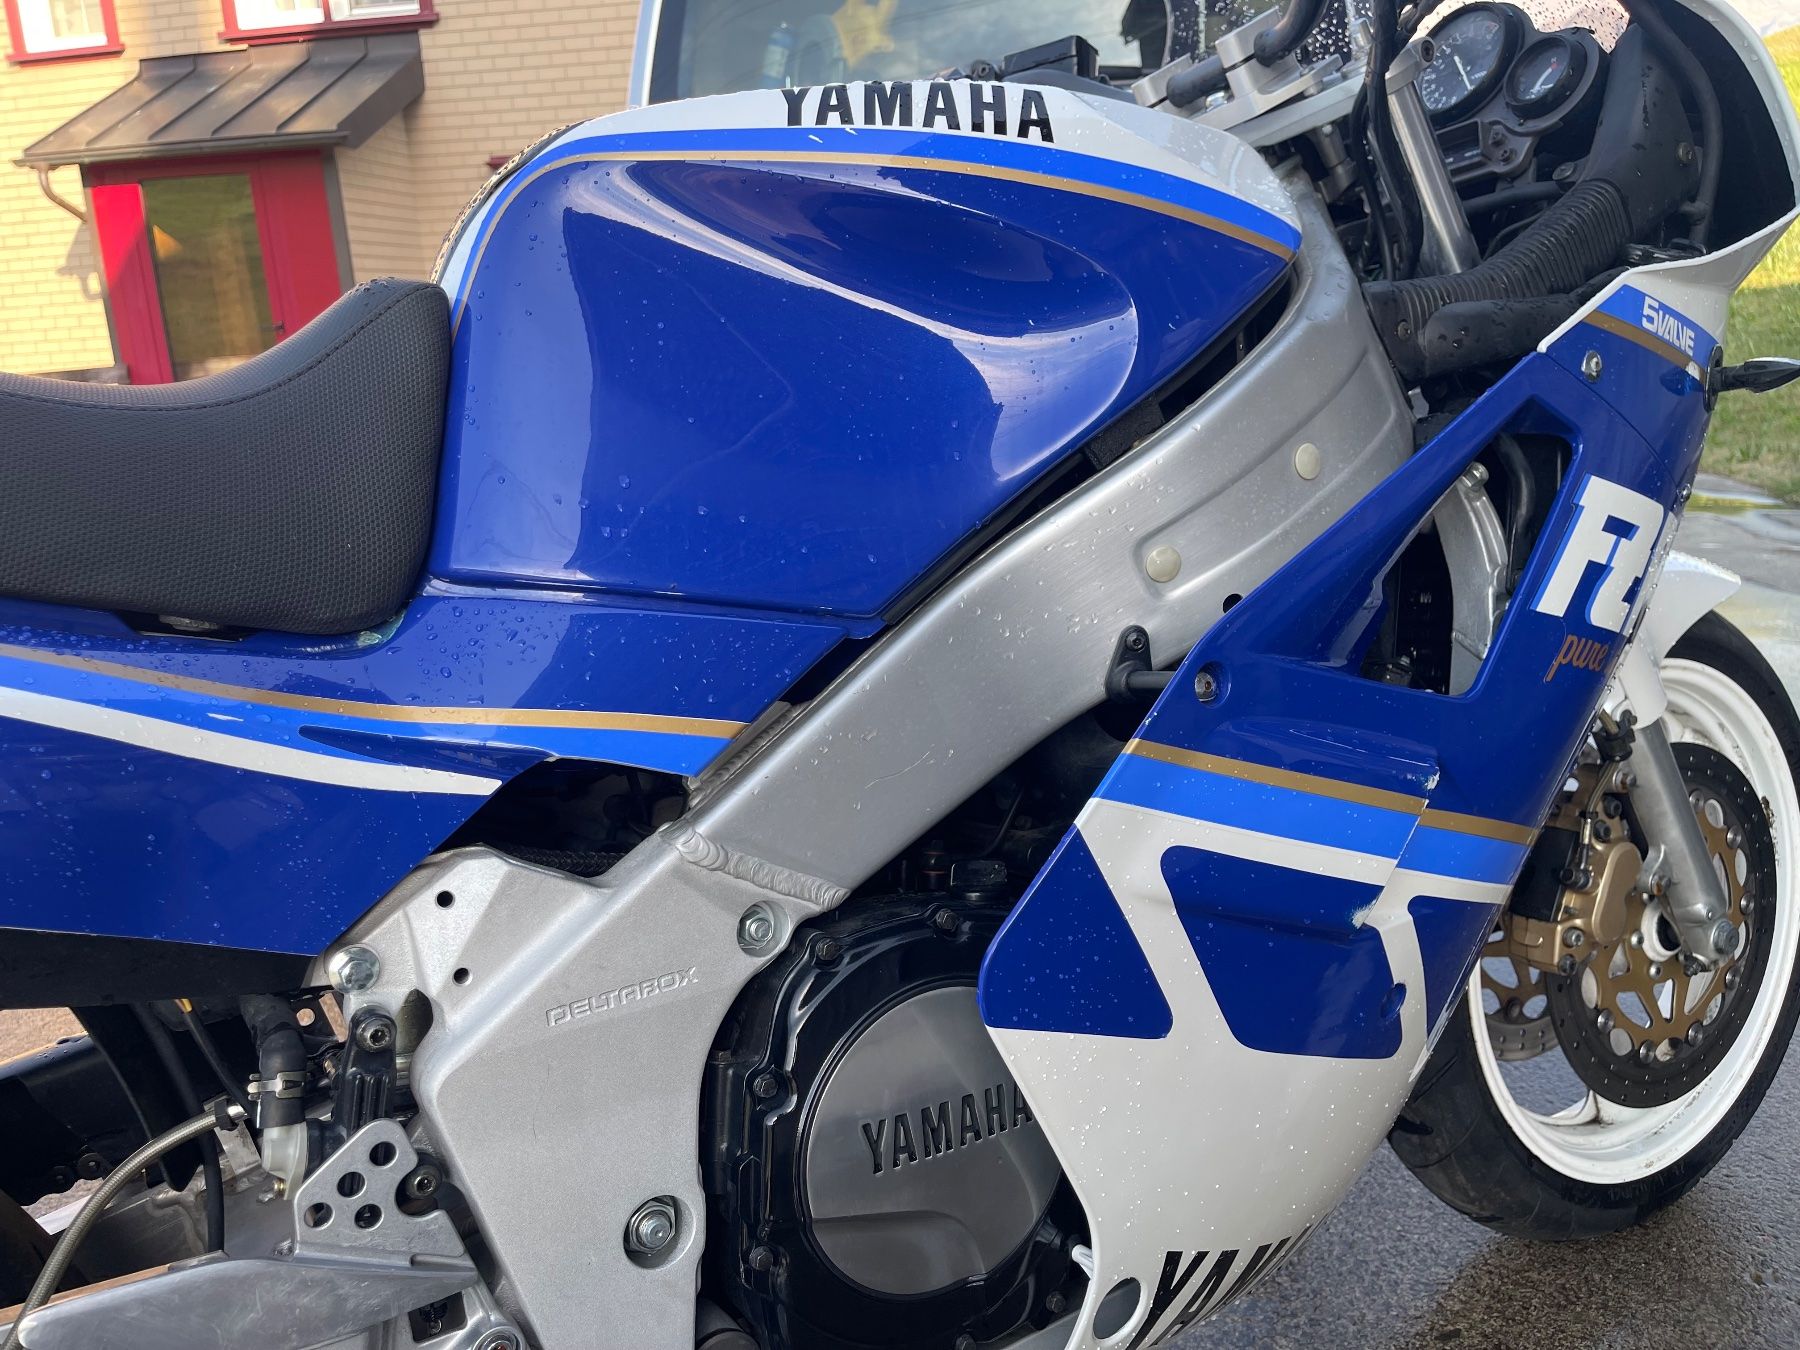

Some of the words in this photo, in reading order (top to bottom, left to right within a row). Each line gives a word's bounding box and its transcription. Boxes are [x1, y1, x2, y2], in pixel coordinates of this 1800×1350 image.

[781, 80, 1055, 144] YAMAHA
[546, 966, 699, 1027] DELTABOX
[862, 1082, 1034, 1176] YAMAHA
